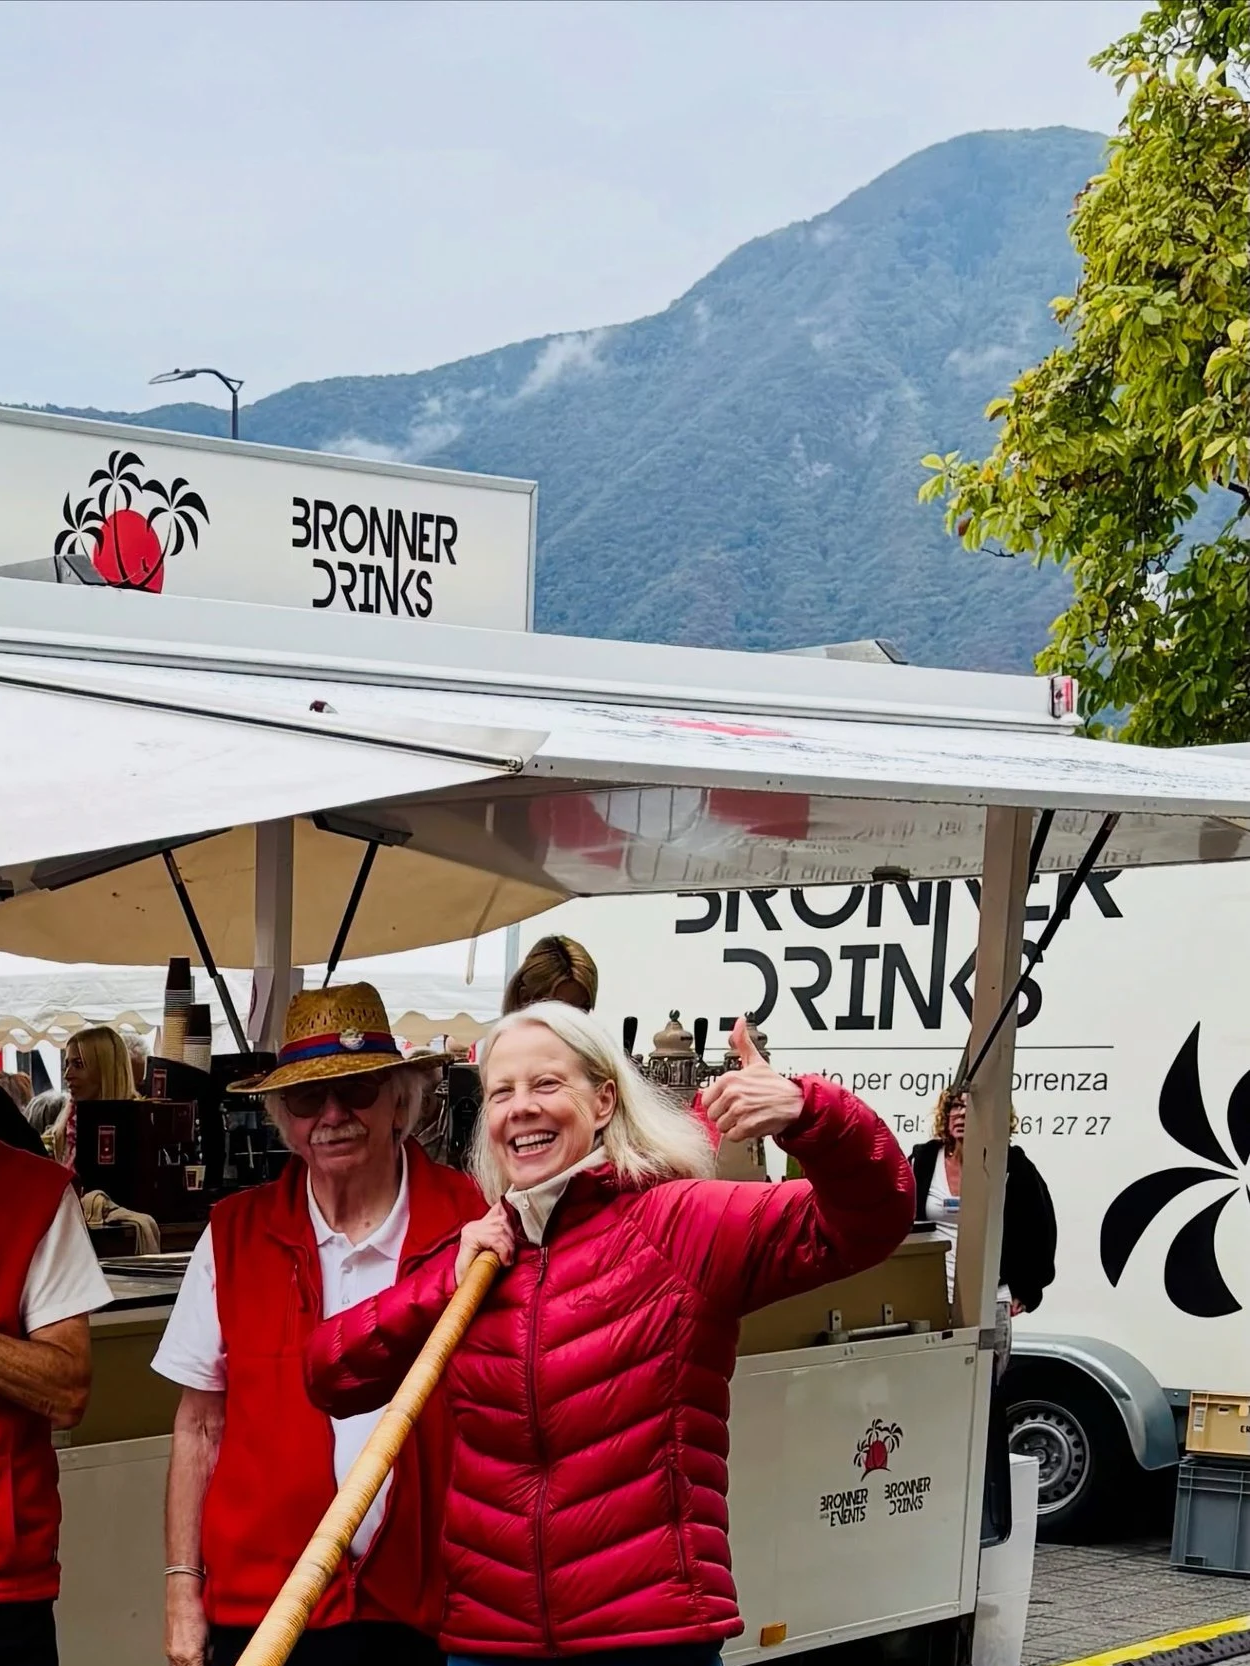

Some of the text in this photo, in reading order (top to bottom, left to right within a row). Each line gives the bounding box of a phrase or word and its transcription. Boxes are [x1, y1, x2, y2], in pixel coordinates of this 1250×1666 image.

[291, 496, 458, 566] BRONNER
[312, 557, 434, 619] DRINKS
[852, 1071, 892, 1094] per
[899, 1067, 952, 1097] ogni
[1012, 1071, 1108, 1092] orrenza
[893, 1114, 926, 1133] Tel:
[1052, 1116, 1078, 1135] 27
[1085, 1116, 1112, 1136] 27
[820, 1488, 868, 1512] BRONNER
[884, 1476, 931, 1500] BRONNER
[830, 1506, 866, 1527] EVENTS
[889, 1495, 924, 1516] DRINKS
